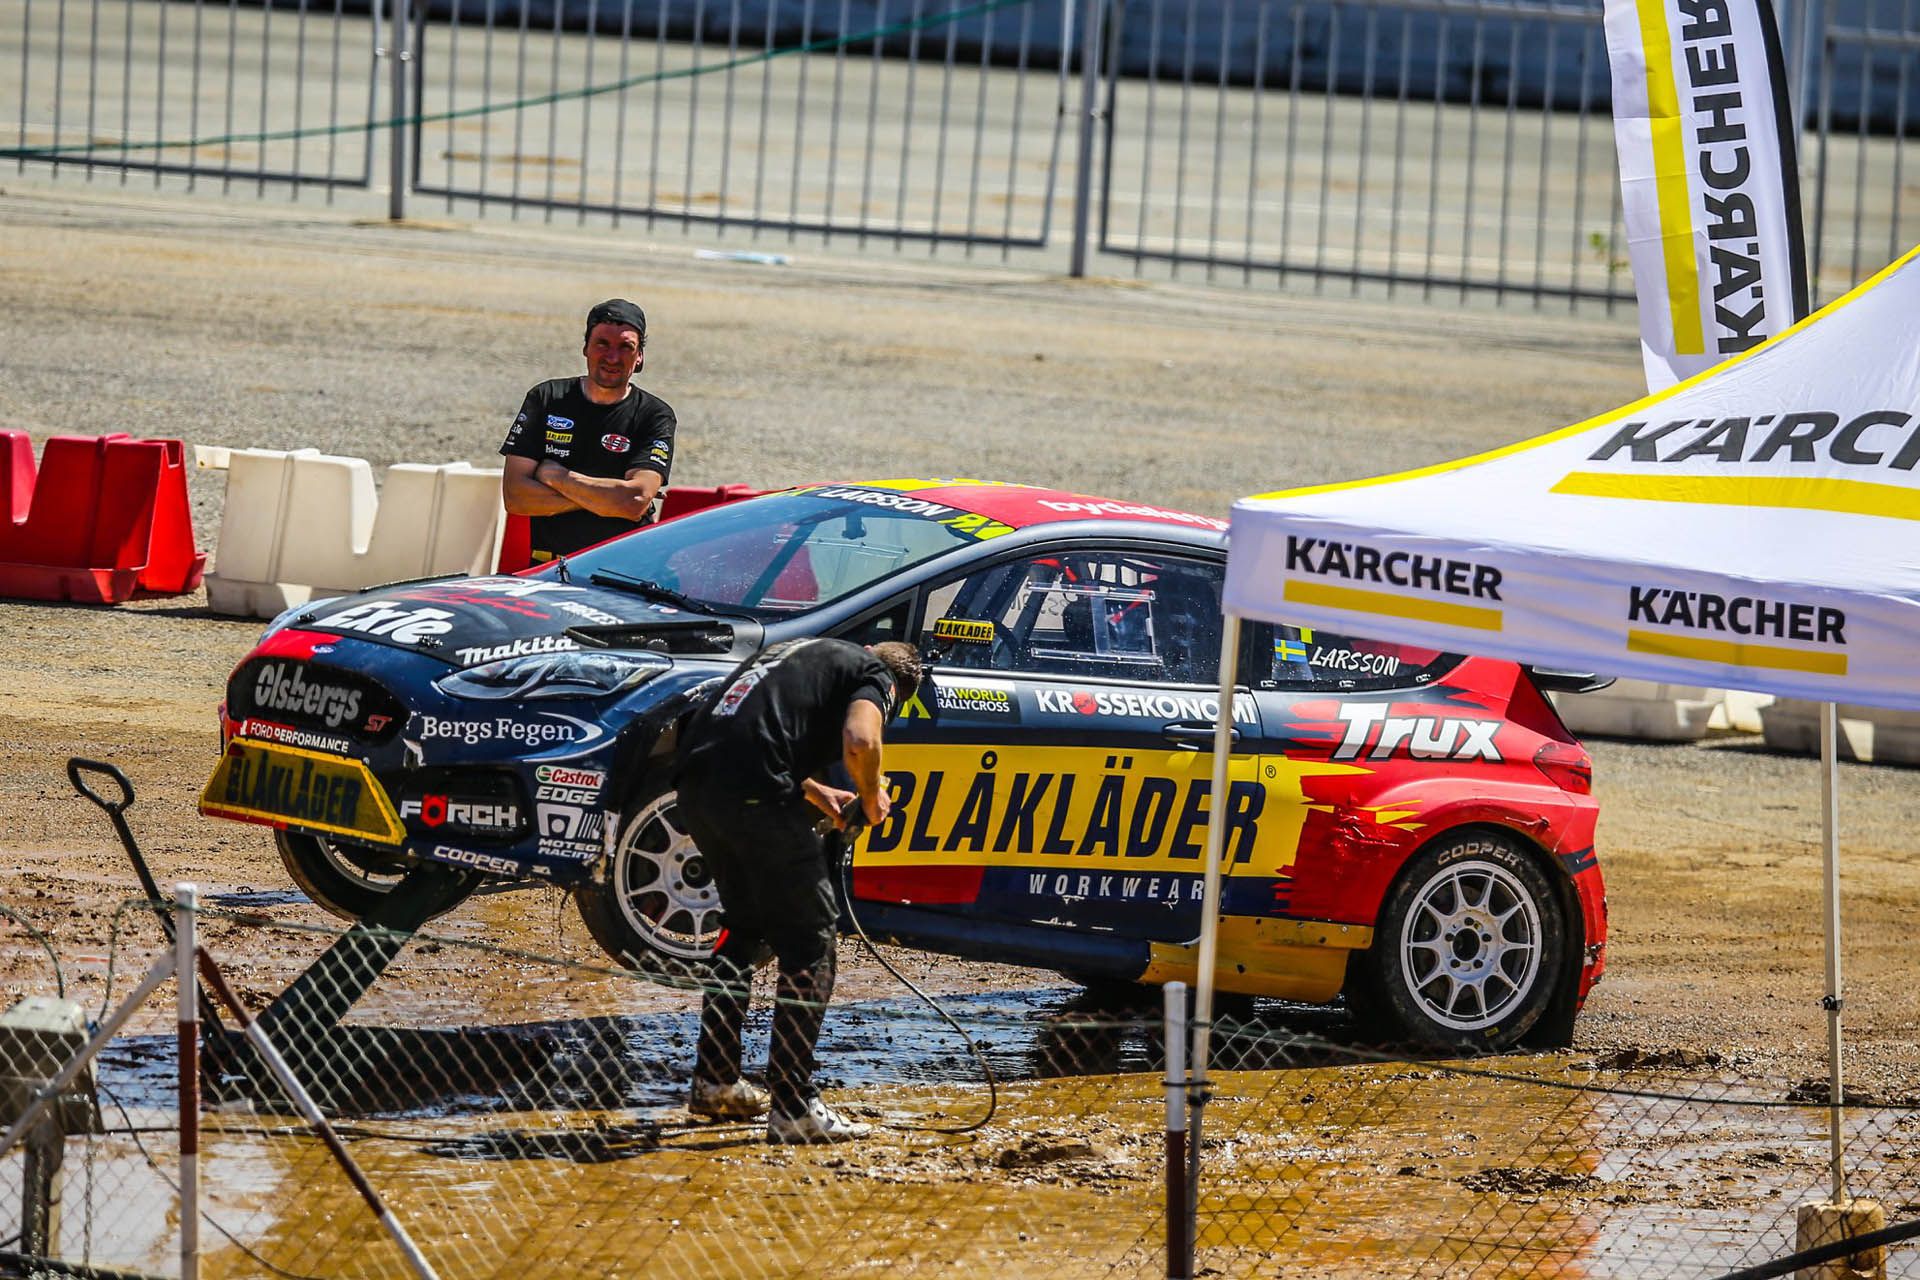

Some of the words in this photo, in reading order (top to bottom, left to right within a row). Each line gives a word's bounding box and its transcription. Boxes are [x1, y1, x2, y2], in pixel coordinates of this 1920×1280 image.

[817, 488, 954, 517] LARSSON
[1286, 535, 1503, 601] KÄRCHER
[1628, 586, 1847, 644] KÄRCHER
[455, 636, 580, 664] makita
[1309, 646, 1400, 677] LARSSON
[254, 663, 362, 727] Olsbergs
[937, 698, 1010, 712] RALLYCROSS
[250, 722, 274, 738] FORD
[274, 729, 350, 753] PERFORMANCE
[421, 716, 493, 744] Bergs
[495, 718, 575, 746] Fegen
[1333, 702, 1502, 761] Trux
[552, 768, 602, 786] Castrol
[536, 786, 600, 805] EDGE
[866, 750, 1267, 864] BLÅKLÄDER
[434, 845, 519, 873] COOPER
[1437, 842, 1518, 866] COOPER
[1029, 873, 1205, 899] WORKWEAR
